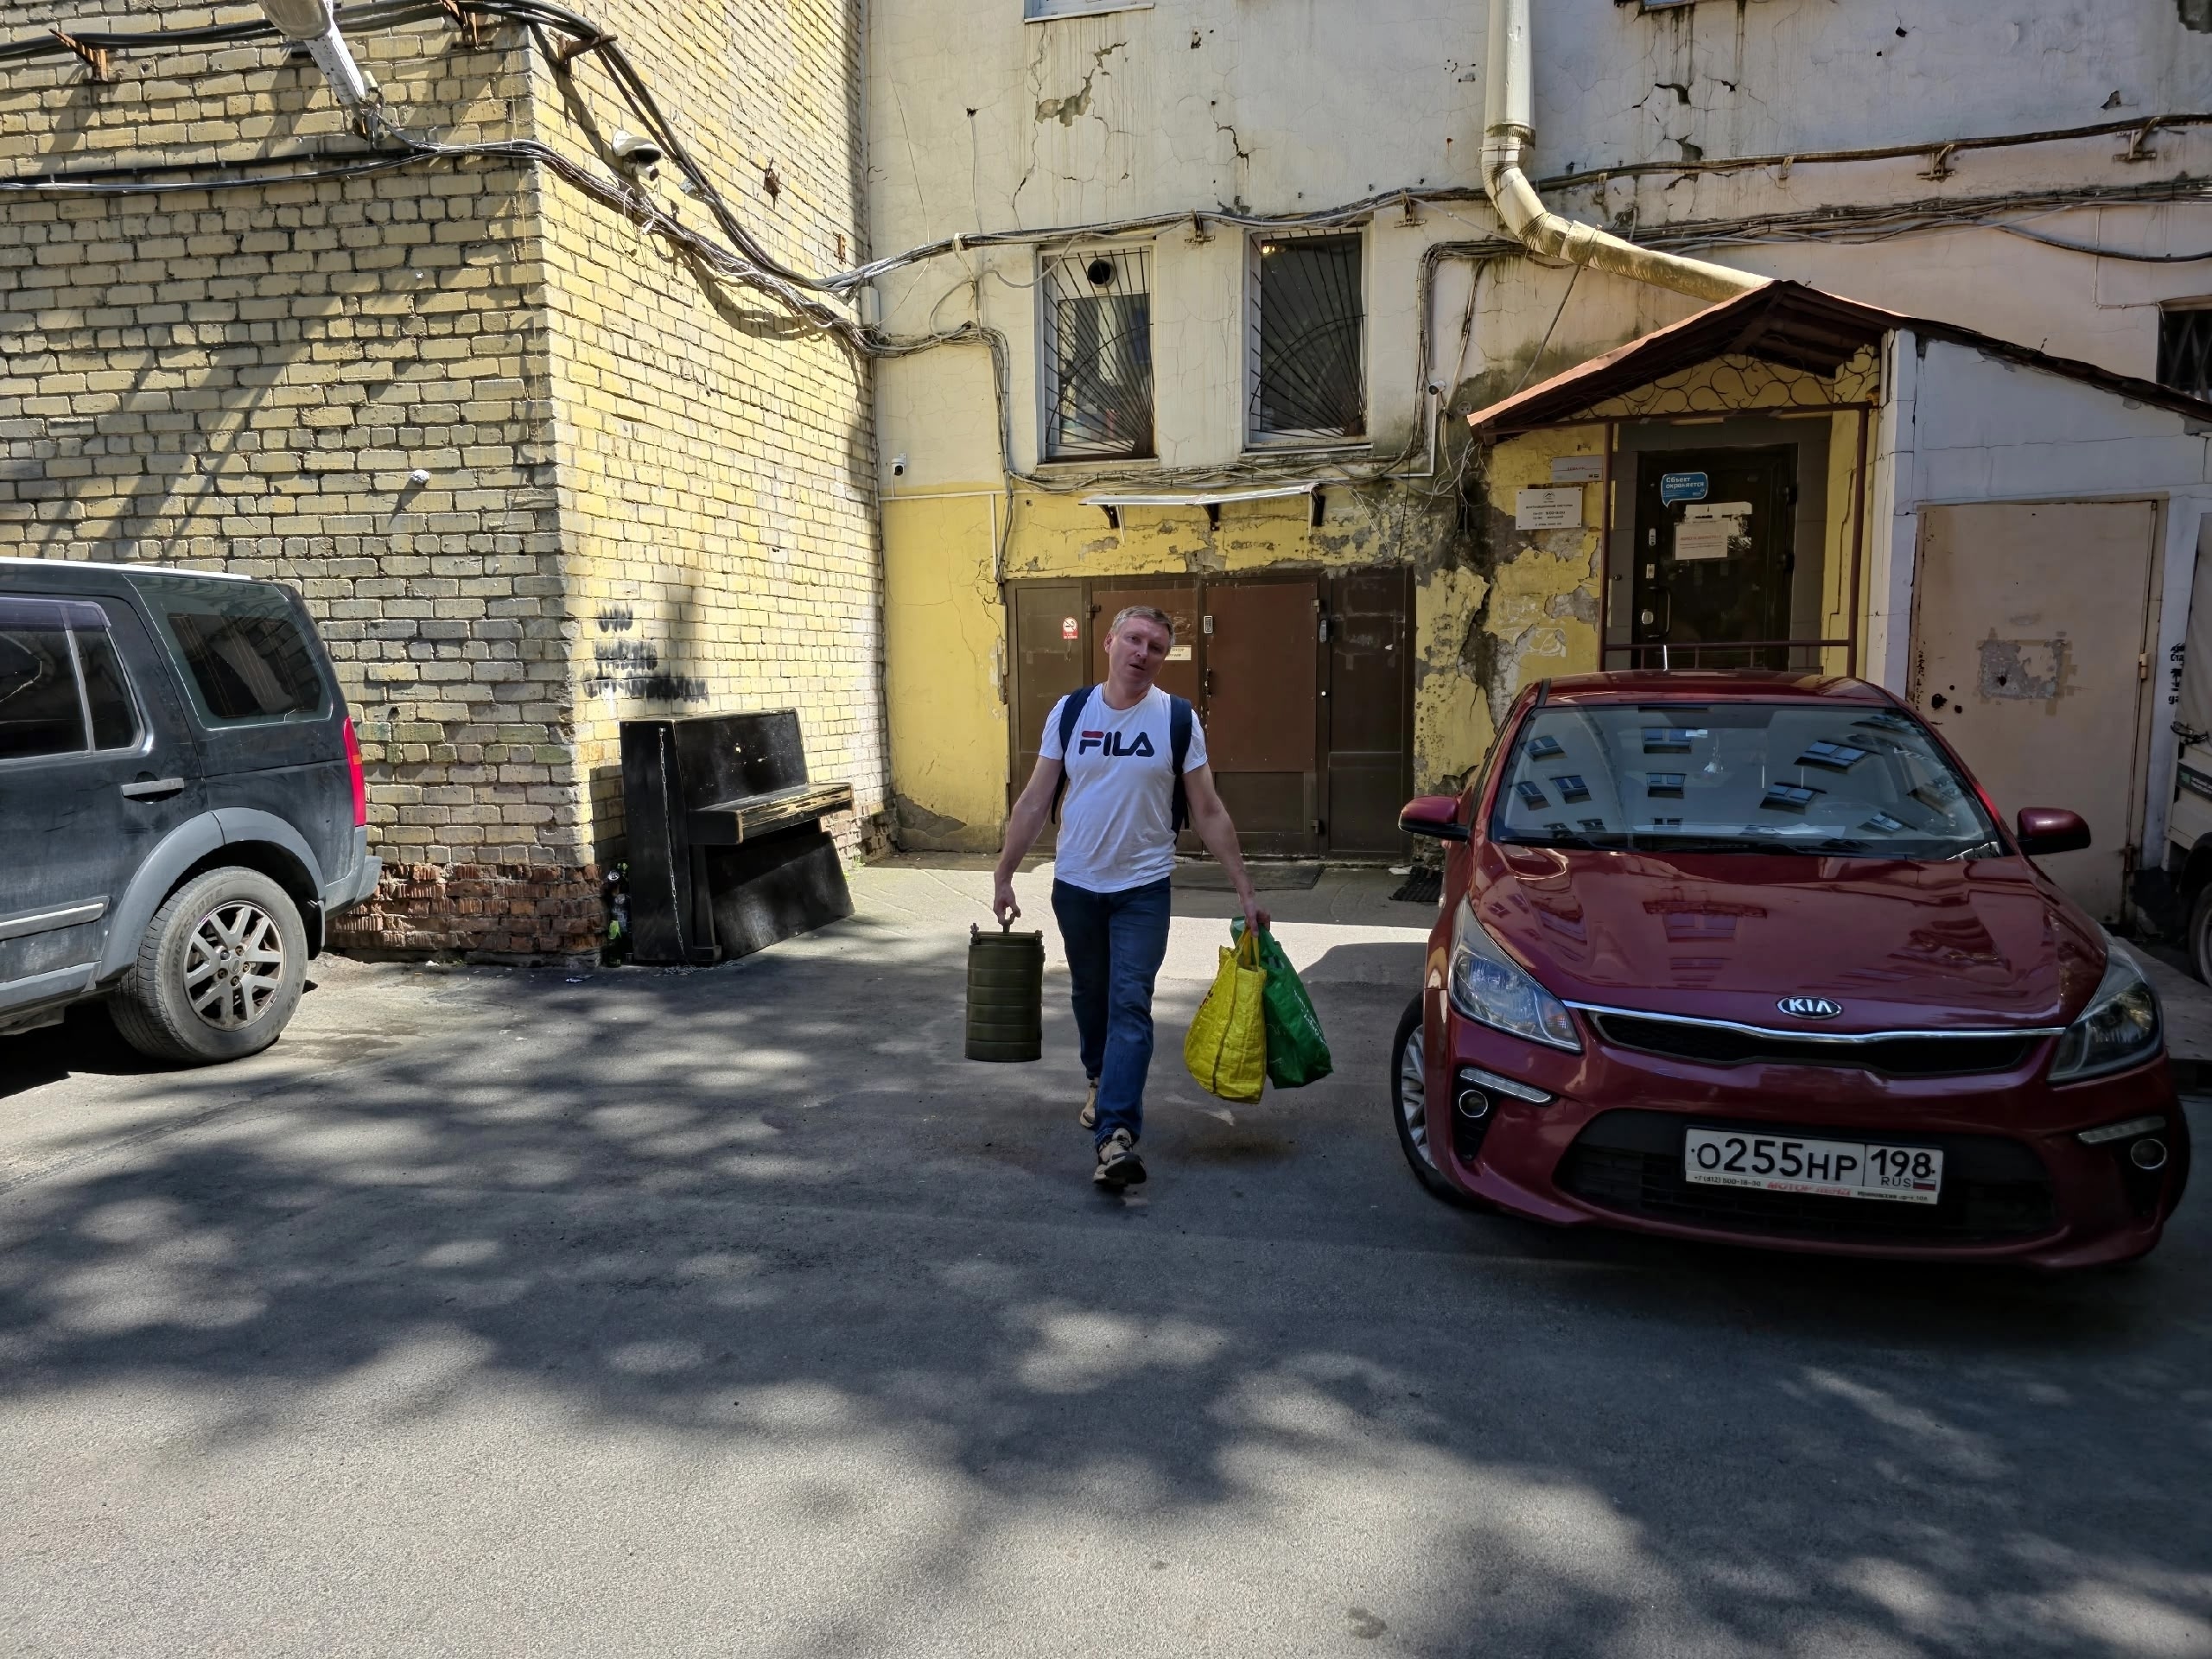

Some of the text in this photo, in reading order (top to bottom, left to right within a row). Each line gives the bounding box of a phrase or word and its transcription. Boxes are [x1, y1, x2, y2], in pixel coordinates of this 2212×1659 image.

[1079, 731, 1154, 757] FILA
[1789, 998, 1833, 1014] KIA
[1870, 1148, 1932, 1179] 198
[1880, 1176, 1911, 1188] RUS
